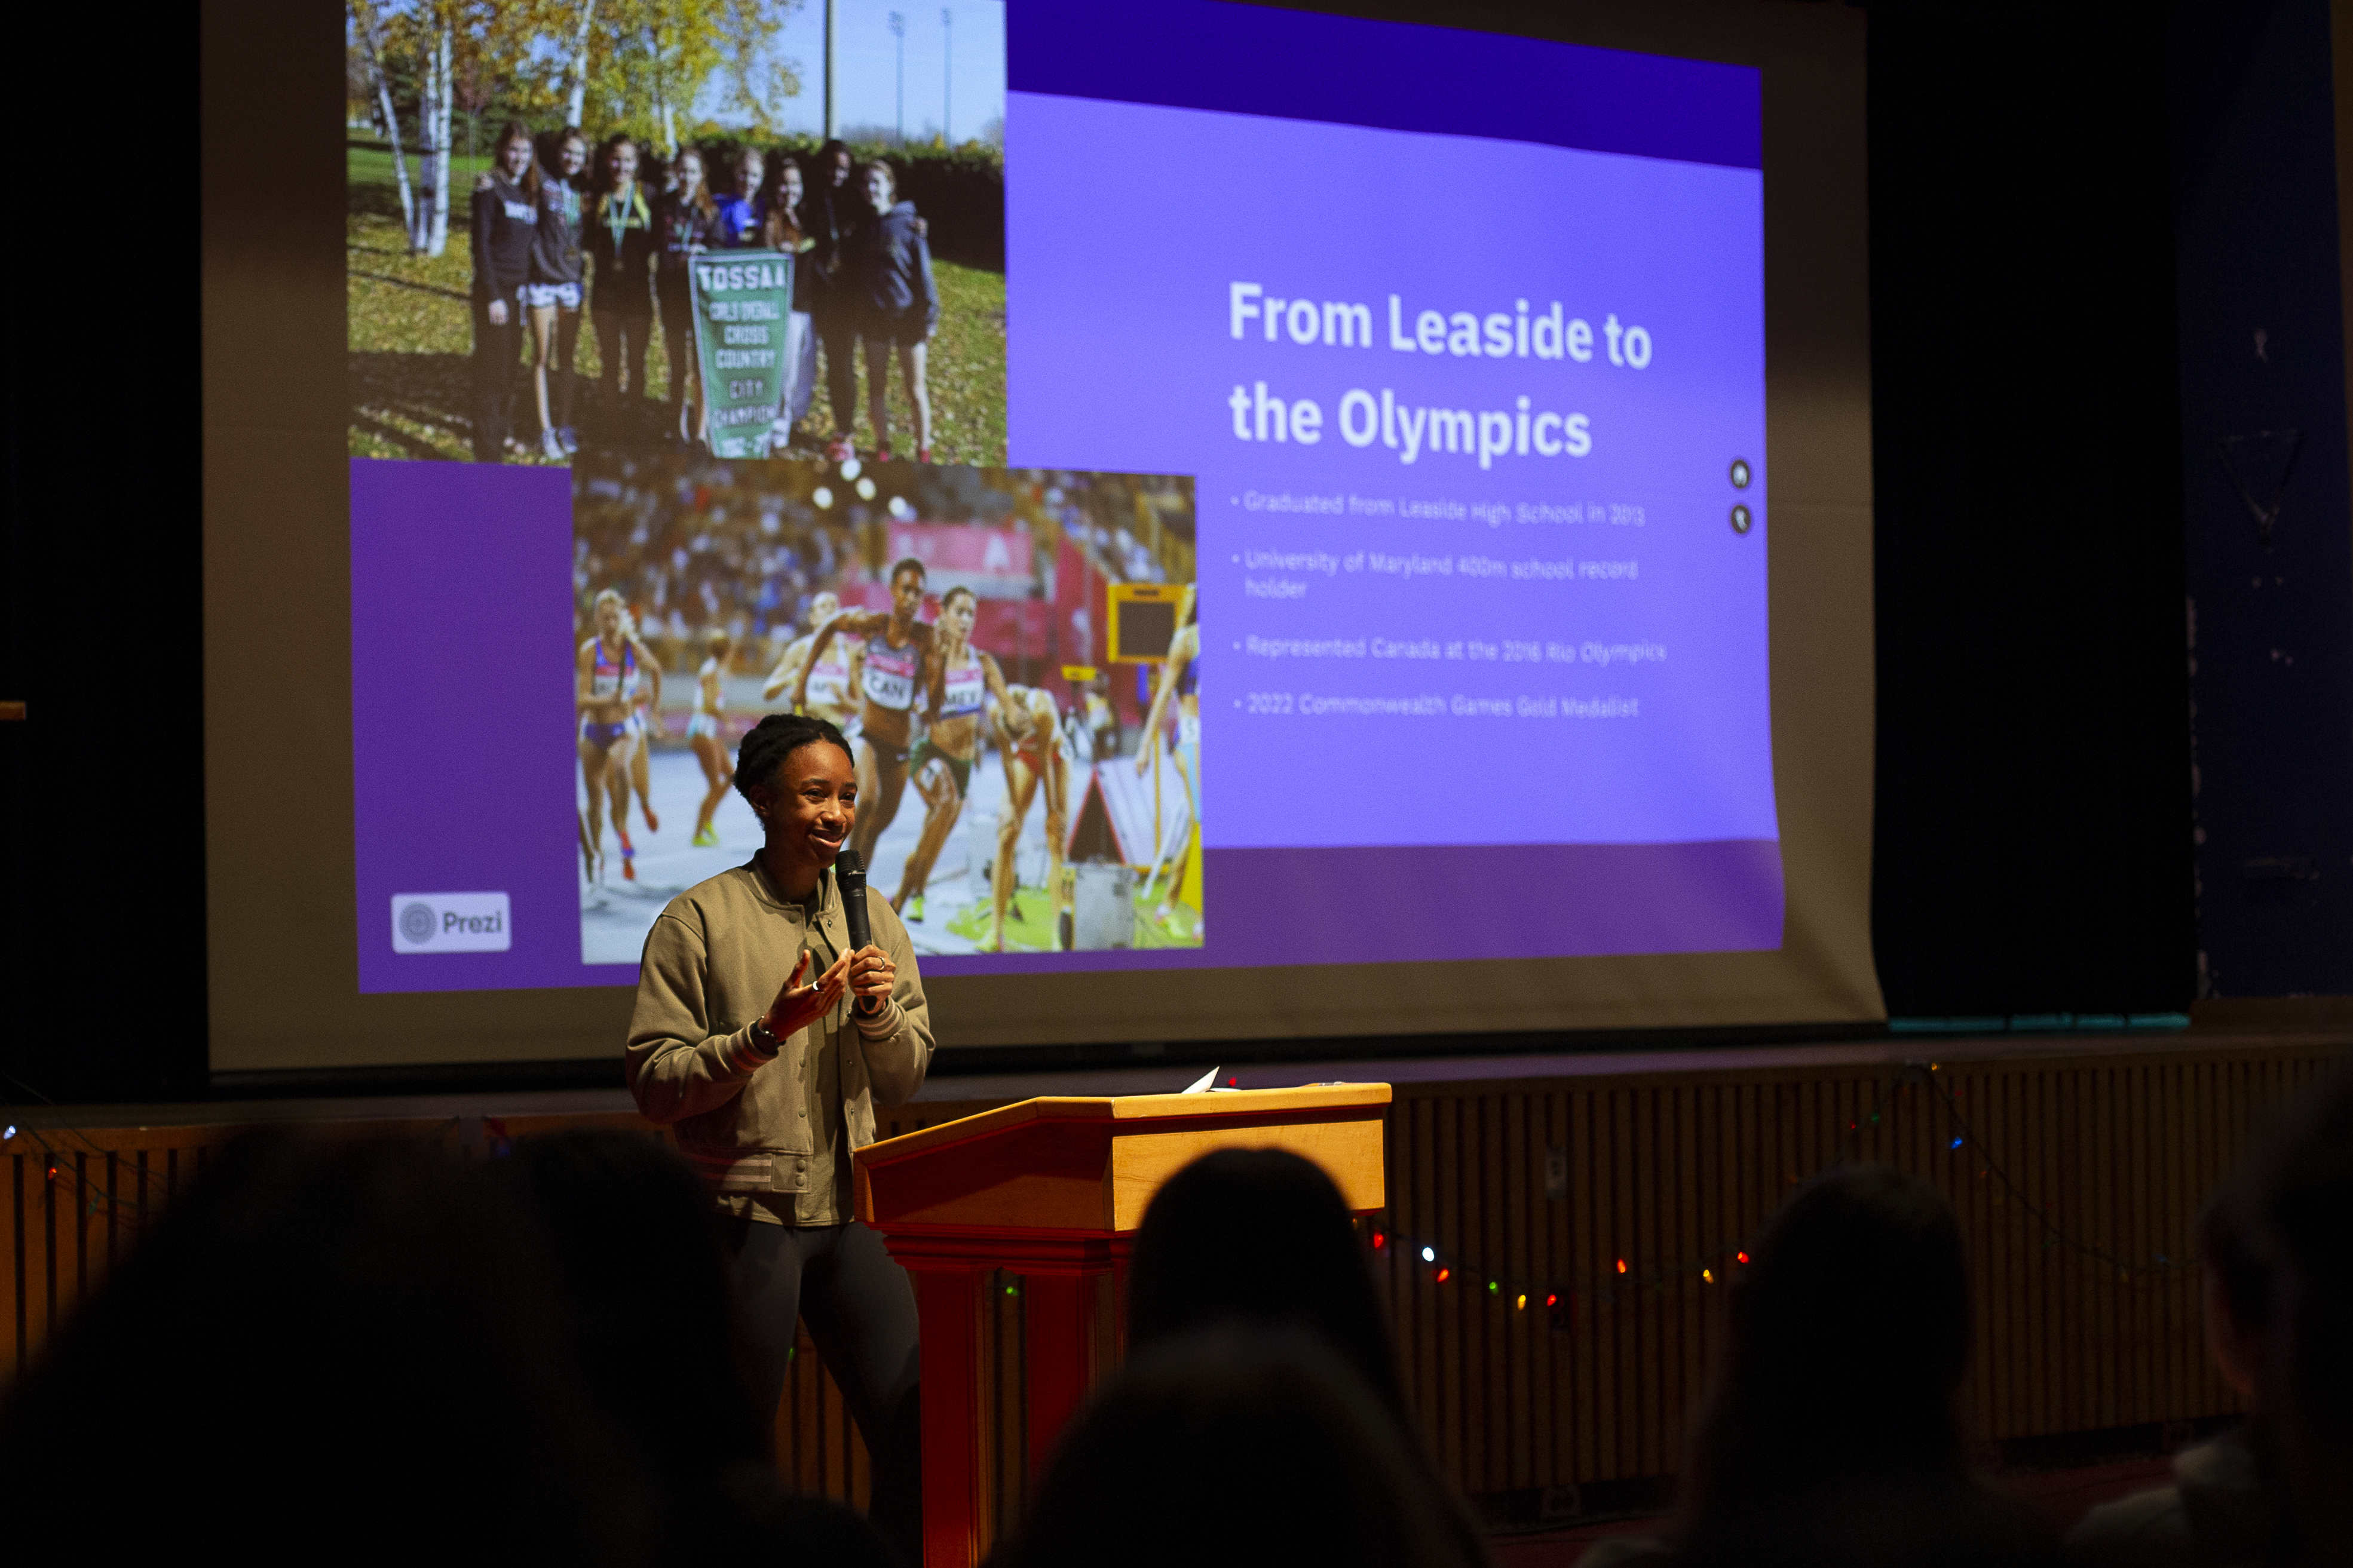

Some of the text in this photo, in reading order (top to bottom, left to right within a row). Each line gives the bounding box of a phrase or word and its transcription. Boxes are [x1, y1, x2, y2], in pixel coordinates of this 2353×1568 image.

[697, 265, 786, 291] TOSSAA
[1229, 281, 1653, 369] From Leaside to
[1228, 381, 1592, 470] the Olympics
[1243, 490, 1344, 515] Graduated
[1348, 495, 1395, 515] from
[1399, 498, 1466, 521] Leaside
[1471, 501, 1511, 527] High
[1516, 502, 1583, 524] School
[1587, 503, 1606, 523] in
[1245, 549, 1340, 576] University
[1343, 550, 1364, 572] of
[1369, 551, 1453, 579] Maryland
[1511, 557, 1574, 580] school
[1578, 560, 1639, 580] record
[1245, 576, 1307, 598] holder
[1246, 634, 1367, 660] Represented
[1371, 637, 1441, 659] Canada
[1444, 641, 1463, 659] at
[1467, 640, 1499, 661] the
[1580, 641, 1668, 667] Olympics
[1248, 691, 1294, 714] 2022
[1298, 692, 1447, 716] Commonwealth
[1450, 694, 1513, 717] Games
[1516, 695, 1558, 718] Gold
[443, 909, 502, 934] Prezi
